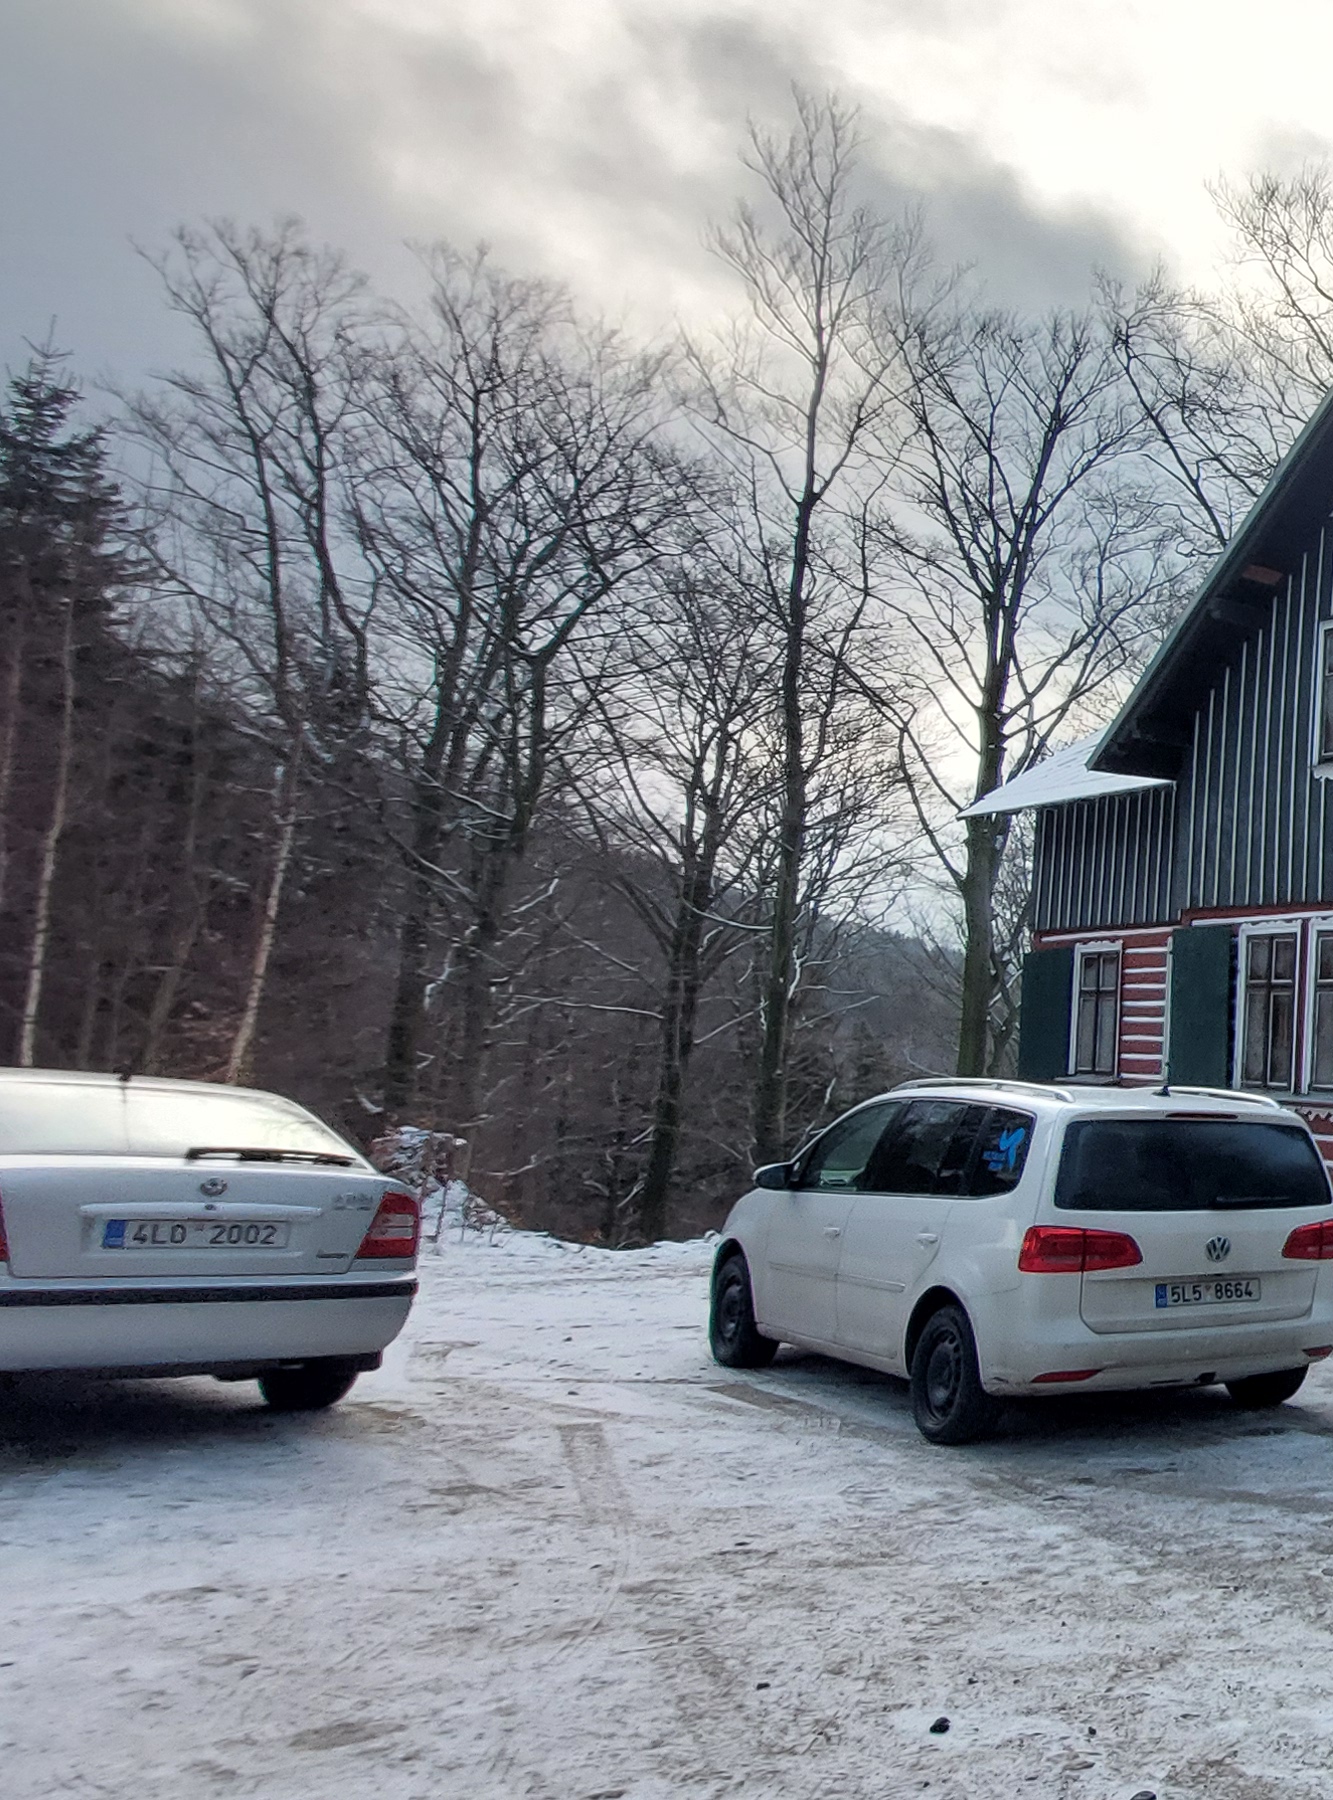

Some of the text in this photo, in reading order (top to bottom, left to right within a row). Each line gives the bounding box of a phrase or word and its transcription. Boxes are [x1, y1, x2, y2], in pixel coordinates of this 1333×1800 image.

[209, 1224, 278, 1244] 2002
[1171, 1282, 1253, 1303] 5L5 8664
